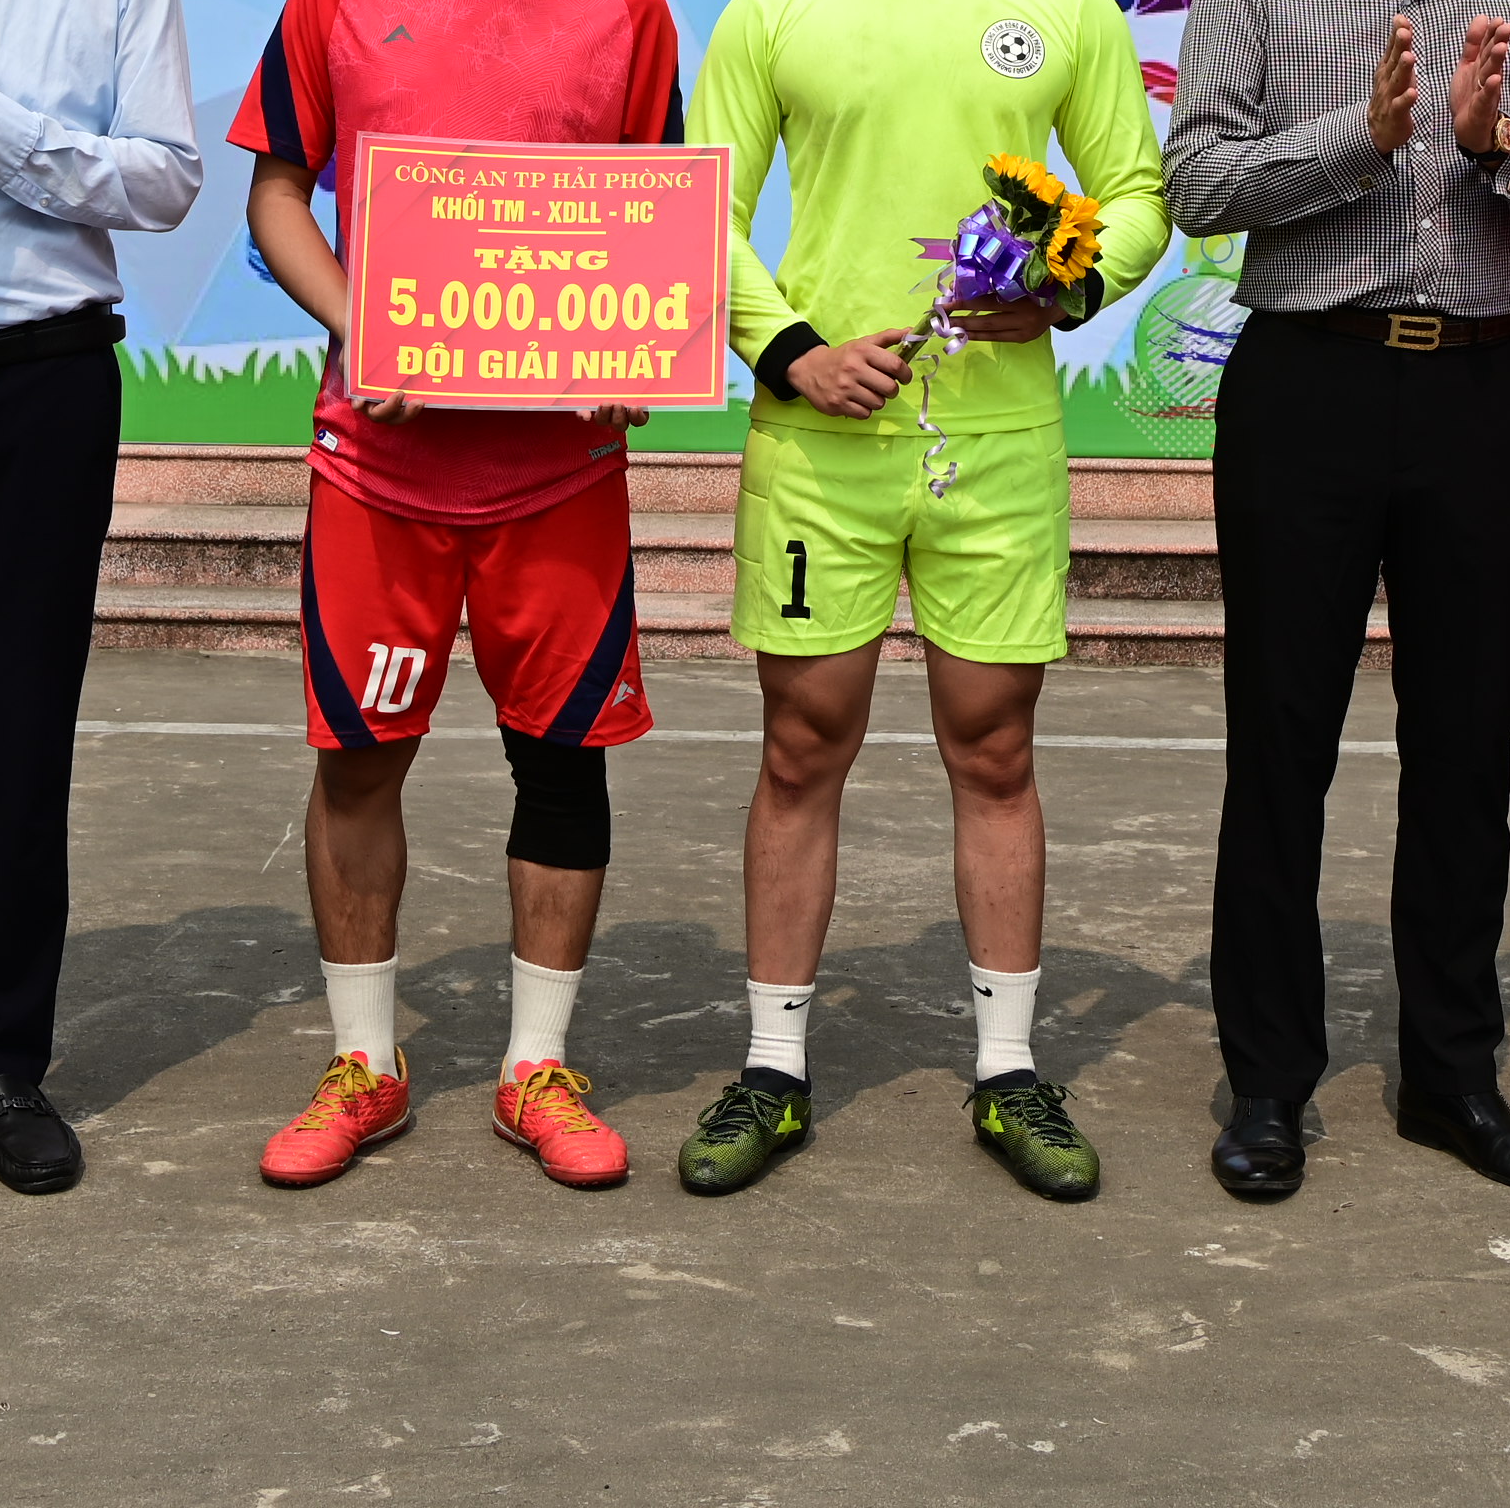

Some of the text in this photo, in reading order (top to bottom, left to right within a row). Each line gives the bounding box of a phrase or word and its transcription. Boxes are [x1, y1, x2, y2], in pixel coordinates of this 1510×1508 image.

[395, 161, 693, 190] CÔNG AN TP HẢI PHÒNG
[431, 190, 485, 221] KHỐI
[492, 199, 525, 223] TM
[547, 200, 601, 224] XDLL
[624, 201, 654, 224] HC
[474, 245, 609, 274] TẶNG
[387, 277, 690, 331] 5.000.000đ
[396, 340, 677, 383] ĐỘI GIẢI NHẤT
[781, 540, 811, 619] 1
[360, 642, 426, 713] 10
